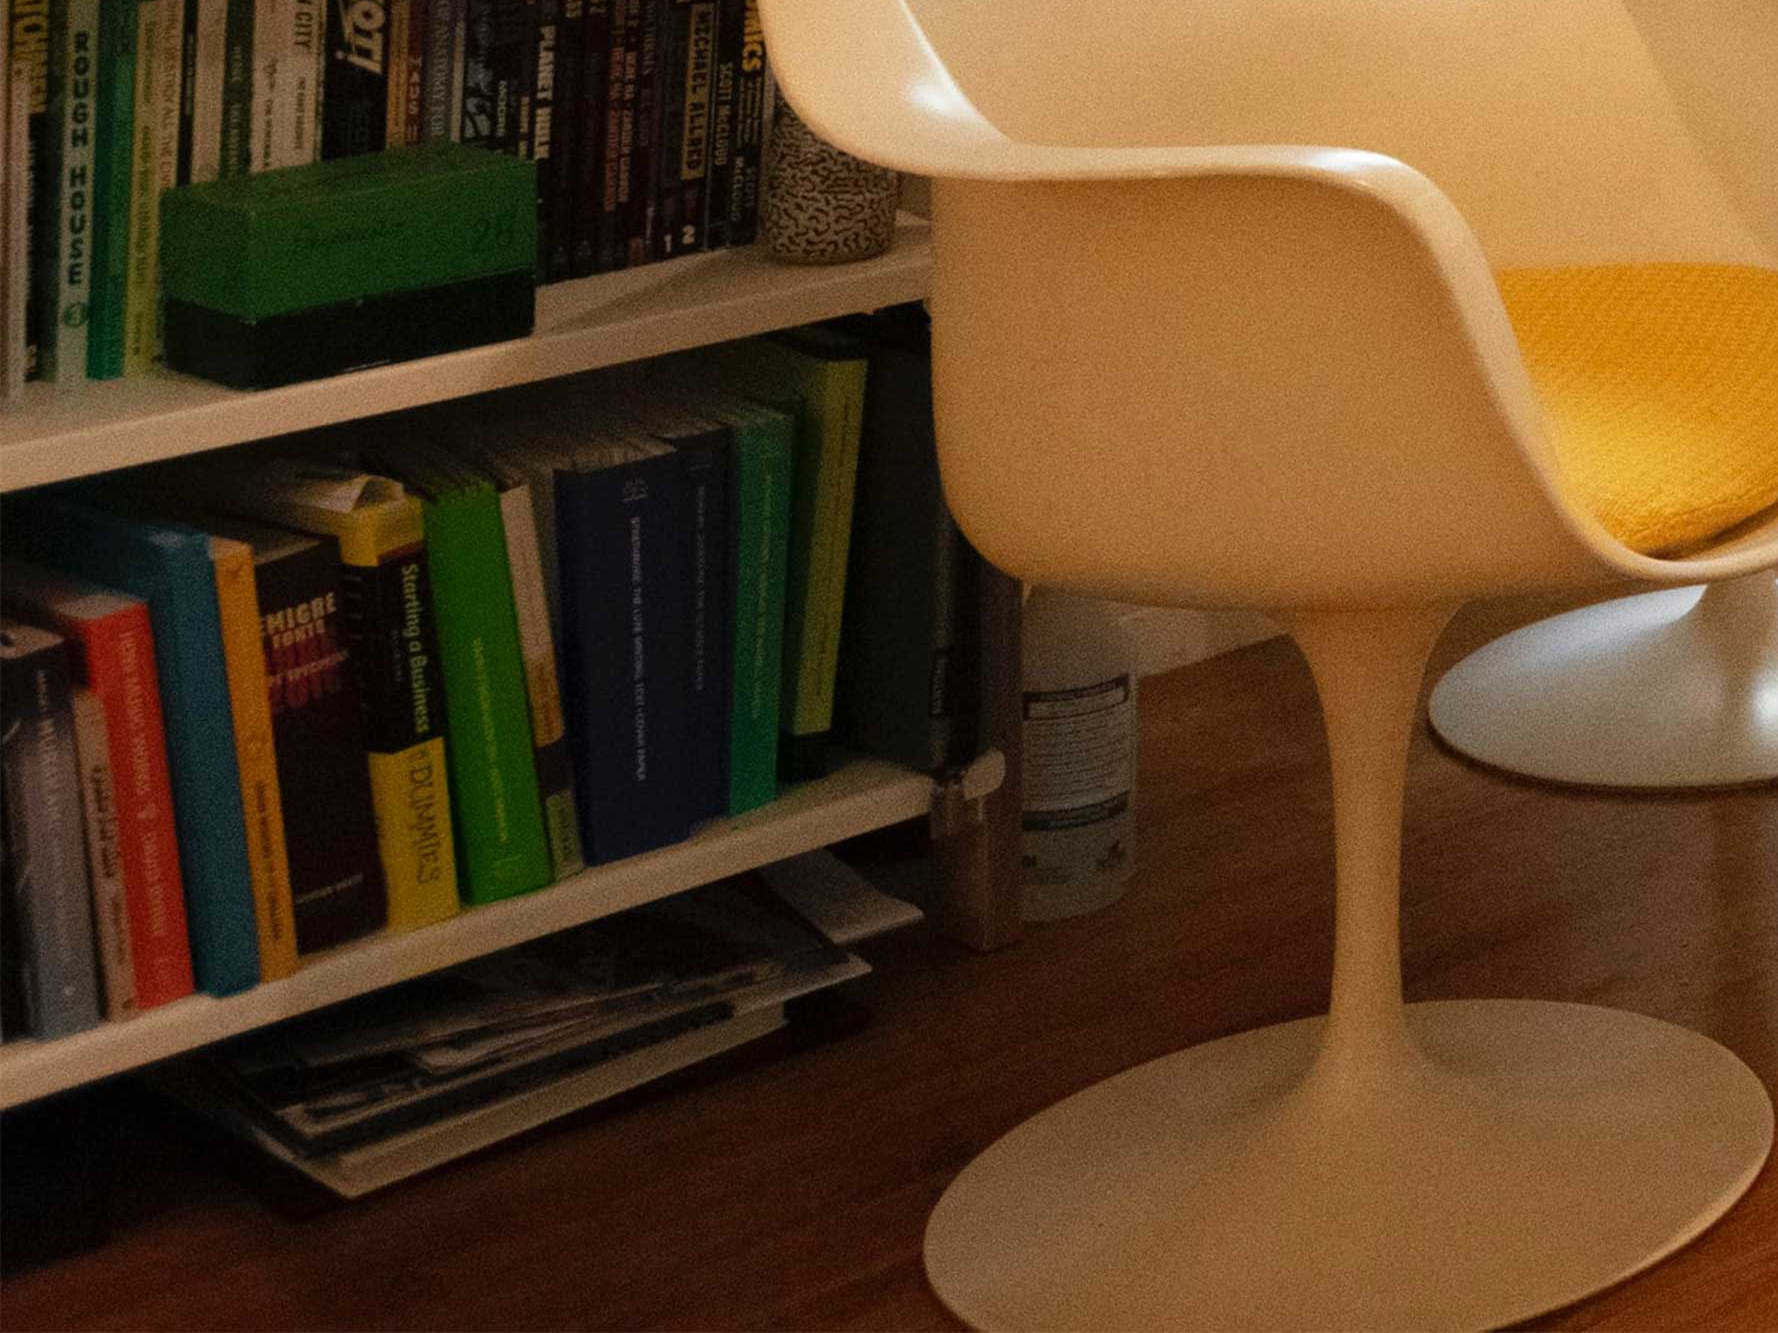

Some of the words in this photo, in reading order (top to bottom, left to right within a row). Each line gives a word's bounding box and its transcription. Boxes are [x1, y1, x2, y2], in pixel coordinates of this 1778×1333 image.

[293, 12, 313, 53] CITY
[536, 25, 558, 102] PLANET
[71, 29, 91, 148] ROUGH
[67, 165, 88, 286] HOUSE
[401, 562, 425, 639] Starting
[409, 641, 423, 652] a
[409, 654, 432, 733] Business
